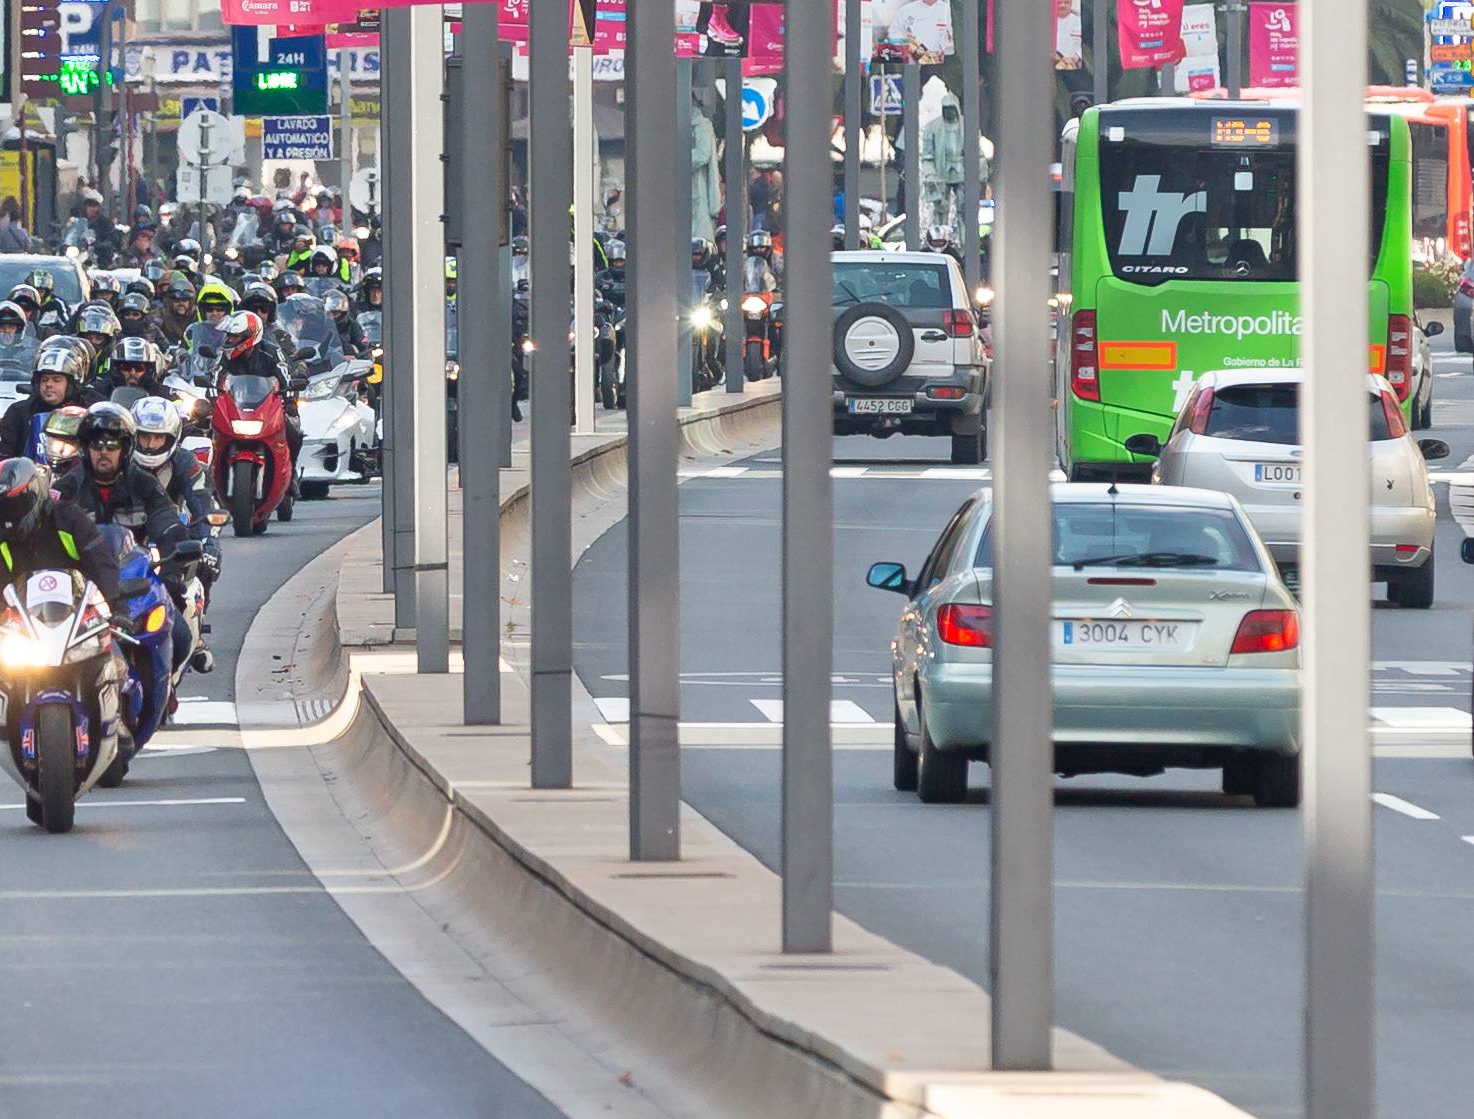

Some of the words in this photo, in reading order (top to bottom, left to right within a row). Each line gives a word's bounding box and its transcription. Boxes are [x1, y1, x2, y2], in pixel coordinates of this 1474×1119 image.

[277, 53, 304, 65] 24H
[277, 119, 318, 130] LAVADO
[267, 148, 274, 158] Y
[276, 148, 284, 158] A
[286, 145, 328, 159] PRESIÓN
[1118, 174, 1207, 256] tr
[1121, 265, 1189, 274] CITARO
[1161, 309, 1304, 341] Metropolita
[1223, 356, 1267, 367] Gobierno
[1268, 357, 1280, 367] de
[1282, 357, 1294, 368] La
[887, 400, 909, 411] CGG
[1080, 623, 1128, 643] 3004
[1141, 623, 1179, 644] CYK
